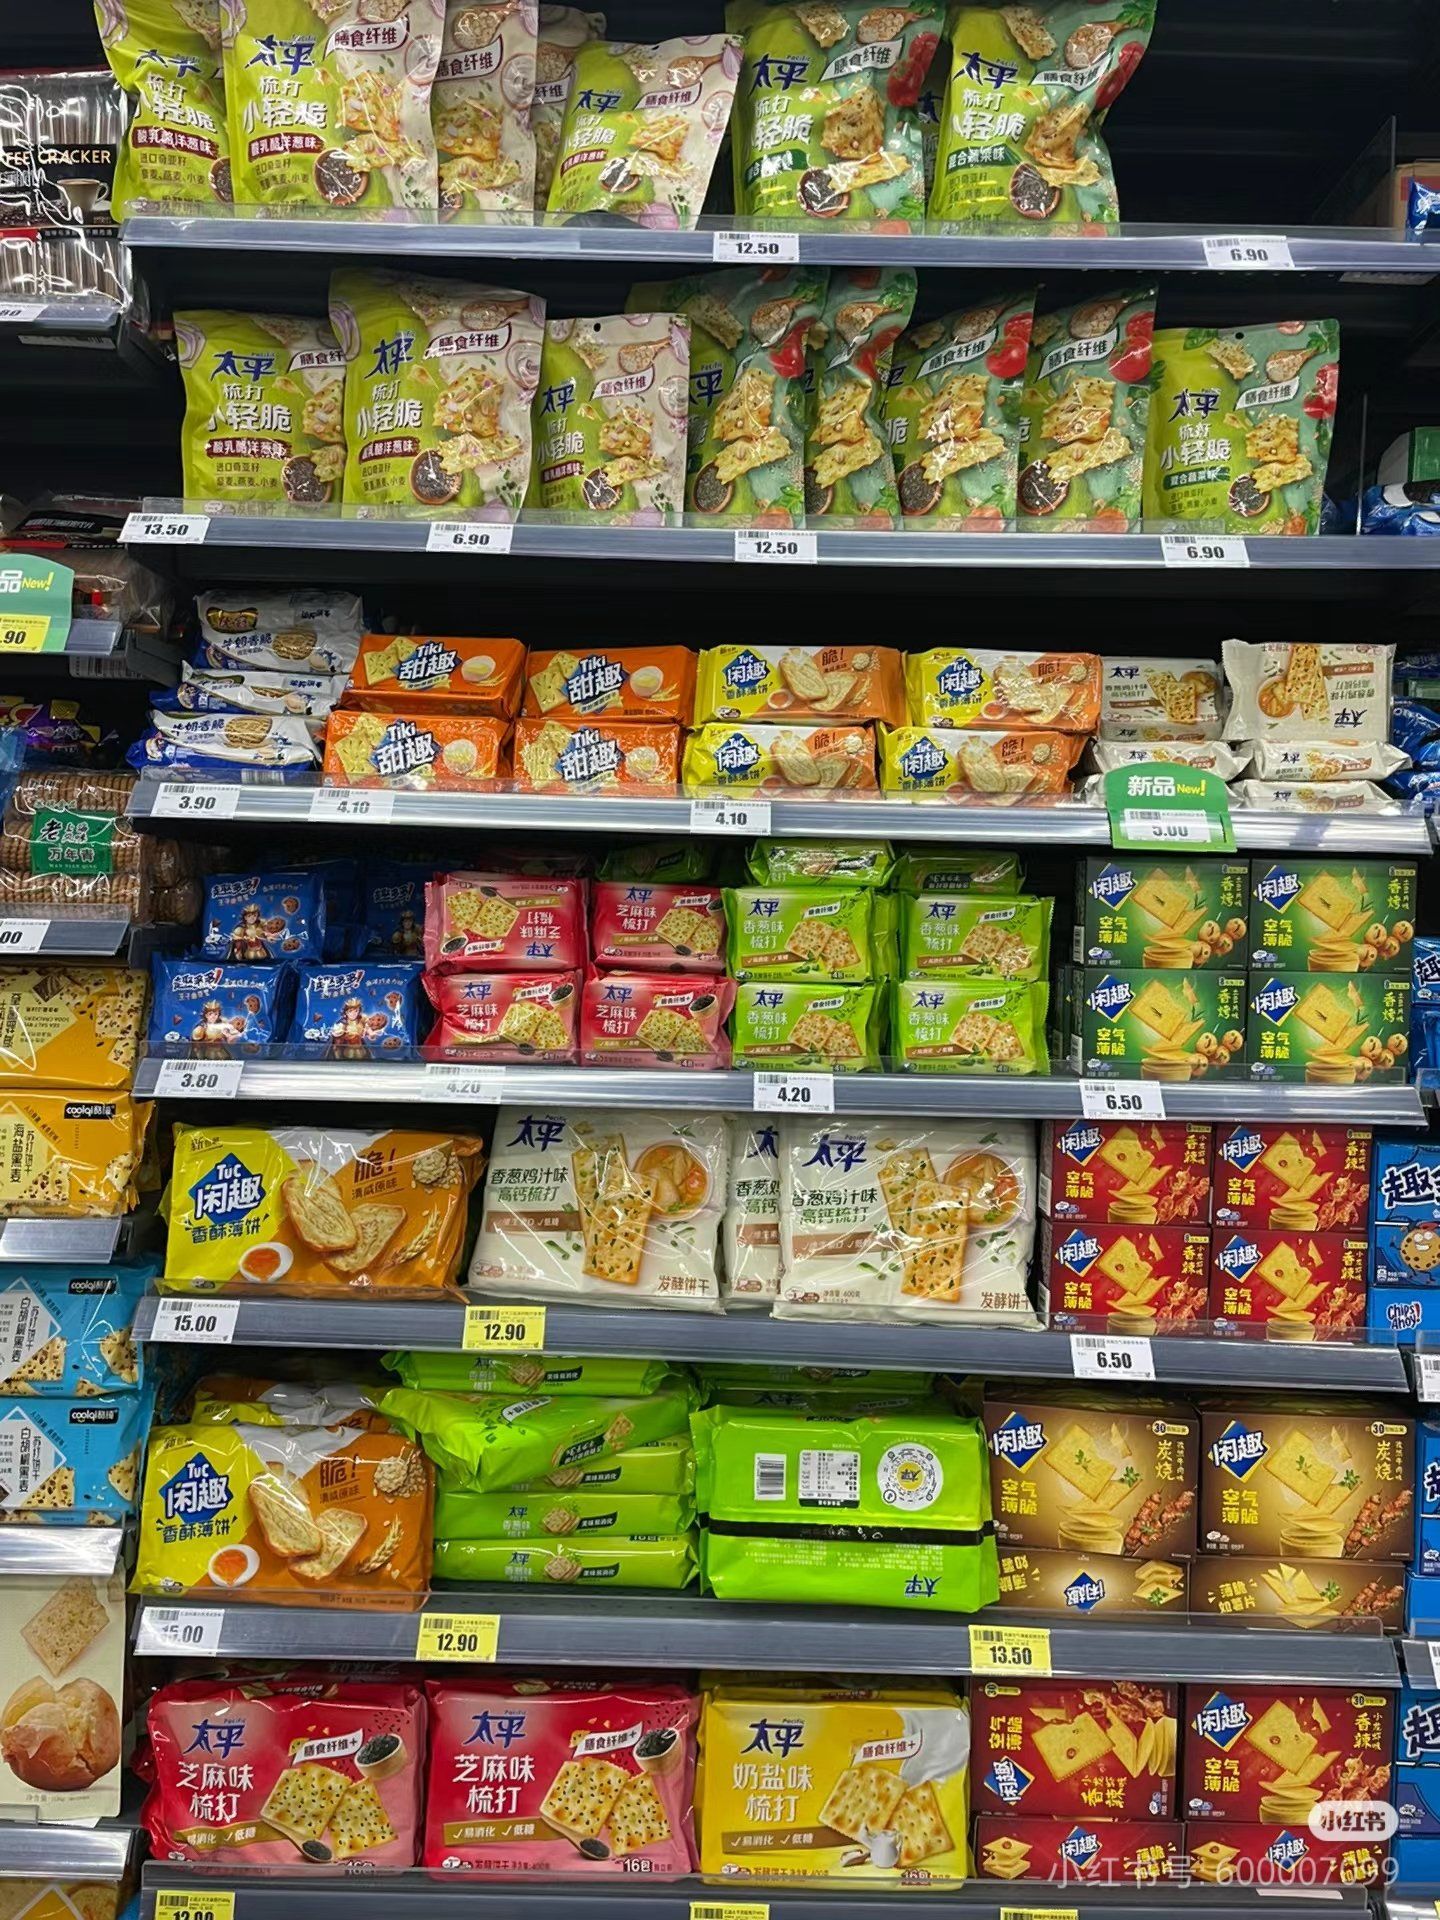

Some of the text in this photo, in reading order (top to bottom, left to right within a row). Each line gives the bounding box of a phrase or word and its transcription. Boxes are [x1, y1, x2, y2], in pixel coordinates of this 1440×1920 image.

[335, 27, 397, 46] 膳食纤维
[244, 34, 319, 73] 太平
[834, 45, 890, 75] 膳食纤维
[753, 55, 812, 88] 太平
[953, 53, 1018, 88] 太平
[244, 98, 327, 133] 小轻脆
[736, 243, 779, 257] 12.50
[1230, 246, 1268, 262] 6.90
[210, 350, 276, 381] 太平
[144, 523, 188, 537] 13.50
[453, 532, 490, 547] 6.90
[755, 541, 798, 556] 12.50
[1187, 546, 1225, 560] 6.90
[22, 572, 53, 592] New!
[417, 643, 443, 656] Tiki
[399, 654, 457, 682] 甜趣
[580, 655, 607, 673] Tiki
[568, 668, 623, 703] 甜趣
[727, 661, 769, 689] 闲趣
[939, 667, 985, 699] 闲趣
[389, 722, 418, 743] Tiki
[571, 728, 600, 750] Tiki
[376, 736, 437, 775] 甜趣
[560, 742, 624, 782] 甜趣
[715, 745, 759, 774] 闲趣
[902, 749, 949, 781] 闲趣
[1127, 776, 1206, 798] 新品 New!
[178, 795, 217, 812] 3.90
[336, 801, 370, 816] 4.10
[715, 810, 747, 827] 4.10
[39, 819, 63, 843] 老
[48, 847, 95, 863] 万年青
[625, 886, 654, 903] 太平
[1092, 872, 1133, 900] 闲趣
[1257, 875, 1299, 902] 闲趣
[616, 904, 658, 918] 芝麻味
[749, 898, 781, 918] 太平
[924, 901, 957, 921] 太平
[622, 918, 651, 932] 梳打
[744, 920, 785, 935] 香葱味
[920, 922, 961, 938] 香葱味
[1098, 915, 1129, 931] 空气
[1262, 919, 1293, 934] 空气
[463, 983, 493, 1001] 太平
[602, 984, 633, 1003] 太平
[755, 989, 786, 1009] 太平
[914, 989, 945, 1010] 太平
[1089, 984, 1132, 1013] 闲趣
[1255, 986, 1296, 1015] 闲趣
[456, 1003, 499, 1019] 芝麻味
[596, 1003, 639, 1019] 芝麻味
[747, 1011, 788, 1027] 香葱味
[908, 1011, 949, 1027] 香葱味
[602, 1018, 630, 1035] 梳打
[1096, 1027, 1126, 1043] 空气
[1260, 1030, 1290, 1046] 空气
[181, 1074, 219, 1090] 3.80
[446, 1079, 483, 1095] 4.20
[778, 1087, 812, 1105] 4.20
[1105, 1094, 1143, 1111] 6.50
[506, 1114, 567, 1152] 太平
[1061, 1125, 1101, 1155] 闲趣
[802, 1134, 867, 1173] 太平
[1221, 1134, 1263, 1164] 闲趣
[491, 1167, 570, 1185] 香葱鸡汁味
[1065, 1170, 1095, 1184] 空气
[1227, 1177, 1256, 1192] 空气
[194, 1176, 262, 1221] 闲趣
[499, 1186, 557, 1203] 高钙梳打
[791, 1186, 878, 1208] 香葱鸡汁味
[191, 1218, 262, 1245] 香酥薄饼
[1060, 1237, 1098, 1267] 闲趣
[1219, 1243, 1259, 1273] 闲趣
[658, 1275, 710, 1297] 发酵饼干
[1063, 1281, 1093, 1296] 空气
[1223, 1287, 1253, 1302] 空气
[1387, 1302, 1415, 1317] Chips
[173, 1314, 218, 1333] 15.00
[484, 1323, 526, 1341] 12.90
[1096, 1350, 1133, 1368] 6.50
[993, 1423, 1043, 1456] 闲趣
[1211, 1432, 1264, 1466] 闲趣
[1156, 1439, 1173, 1482] 炭烧
[1374, 1439, 1393, 1482] 炭烧
[320, 1458, 357, 1489] 脆!
[166, 1475, 228, 1519] 闲趣
[1222, 1487, 1259, 1508] 空气
[1222, 1507, 1259, 1526] 薄脆
[162, 1520, 232, 1545] 香酥薄饼
[436, 1632, 478, 1652] 12.90
[989, 1644, 1032, 1666] 13.50
[463, 1710, 528, 1751] 太平
[1196, 1703, 1246, 1737] 闲趣
[183, 1718, 245, 1760] 太平
[741, 1718, 805, 1759] 太平
[1354, 1715, 1371, 1751] 香辣
[862, 1740, 919, 1759] 膳食纤维+
[175, 1760, 253, 1793] 芝麻味
[452, 1753, 536, 1783] 芝麻味
[732, 1762, 816, 1793] 奶盐味
[1204, 1758, 1241, 1777] 空气
[1204, 1776, 1240, 1793] 薄脆
[189, 1793, 242, 1825] 梳打
[466, 1785, 522, 1815] 梳打
[744, 1795, 799, 1824] 梳打
